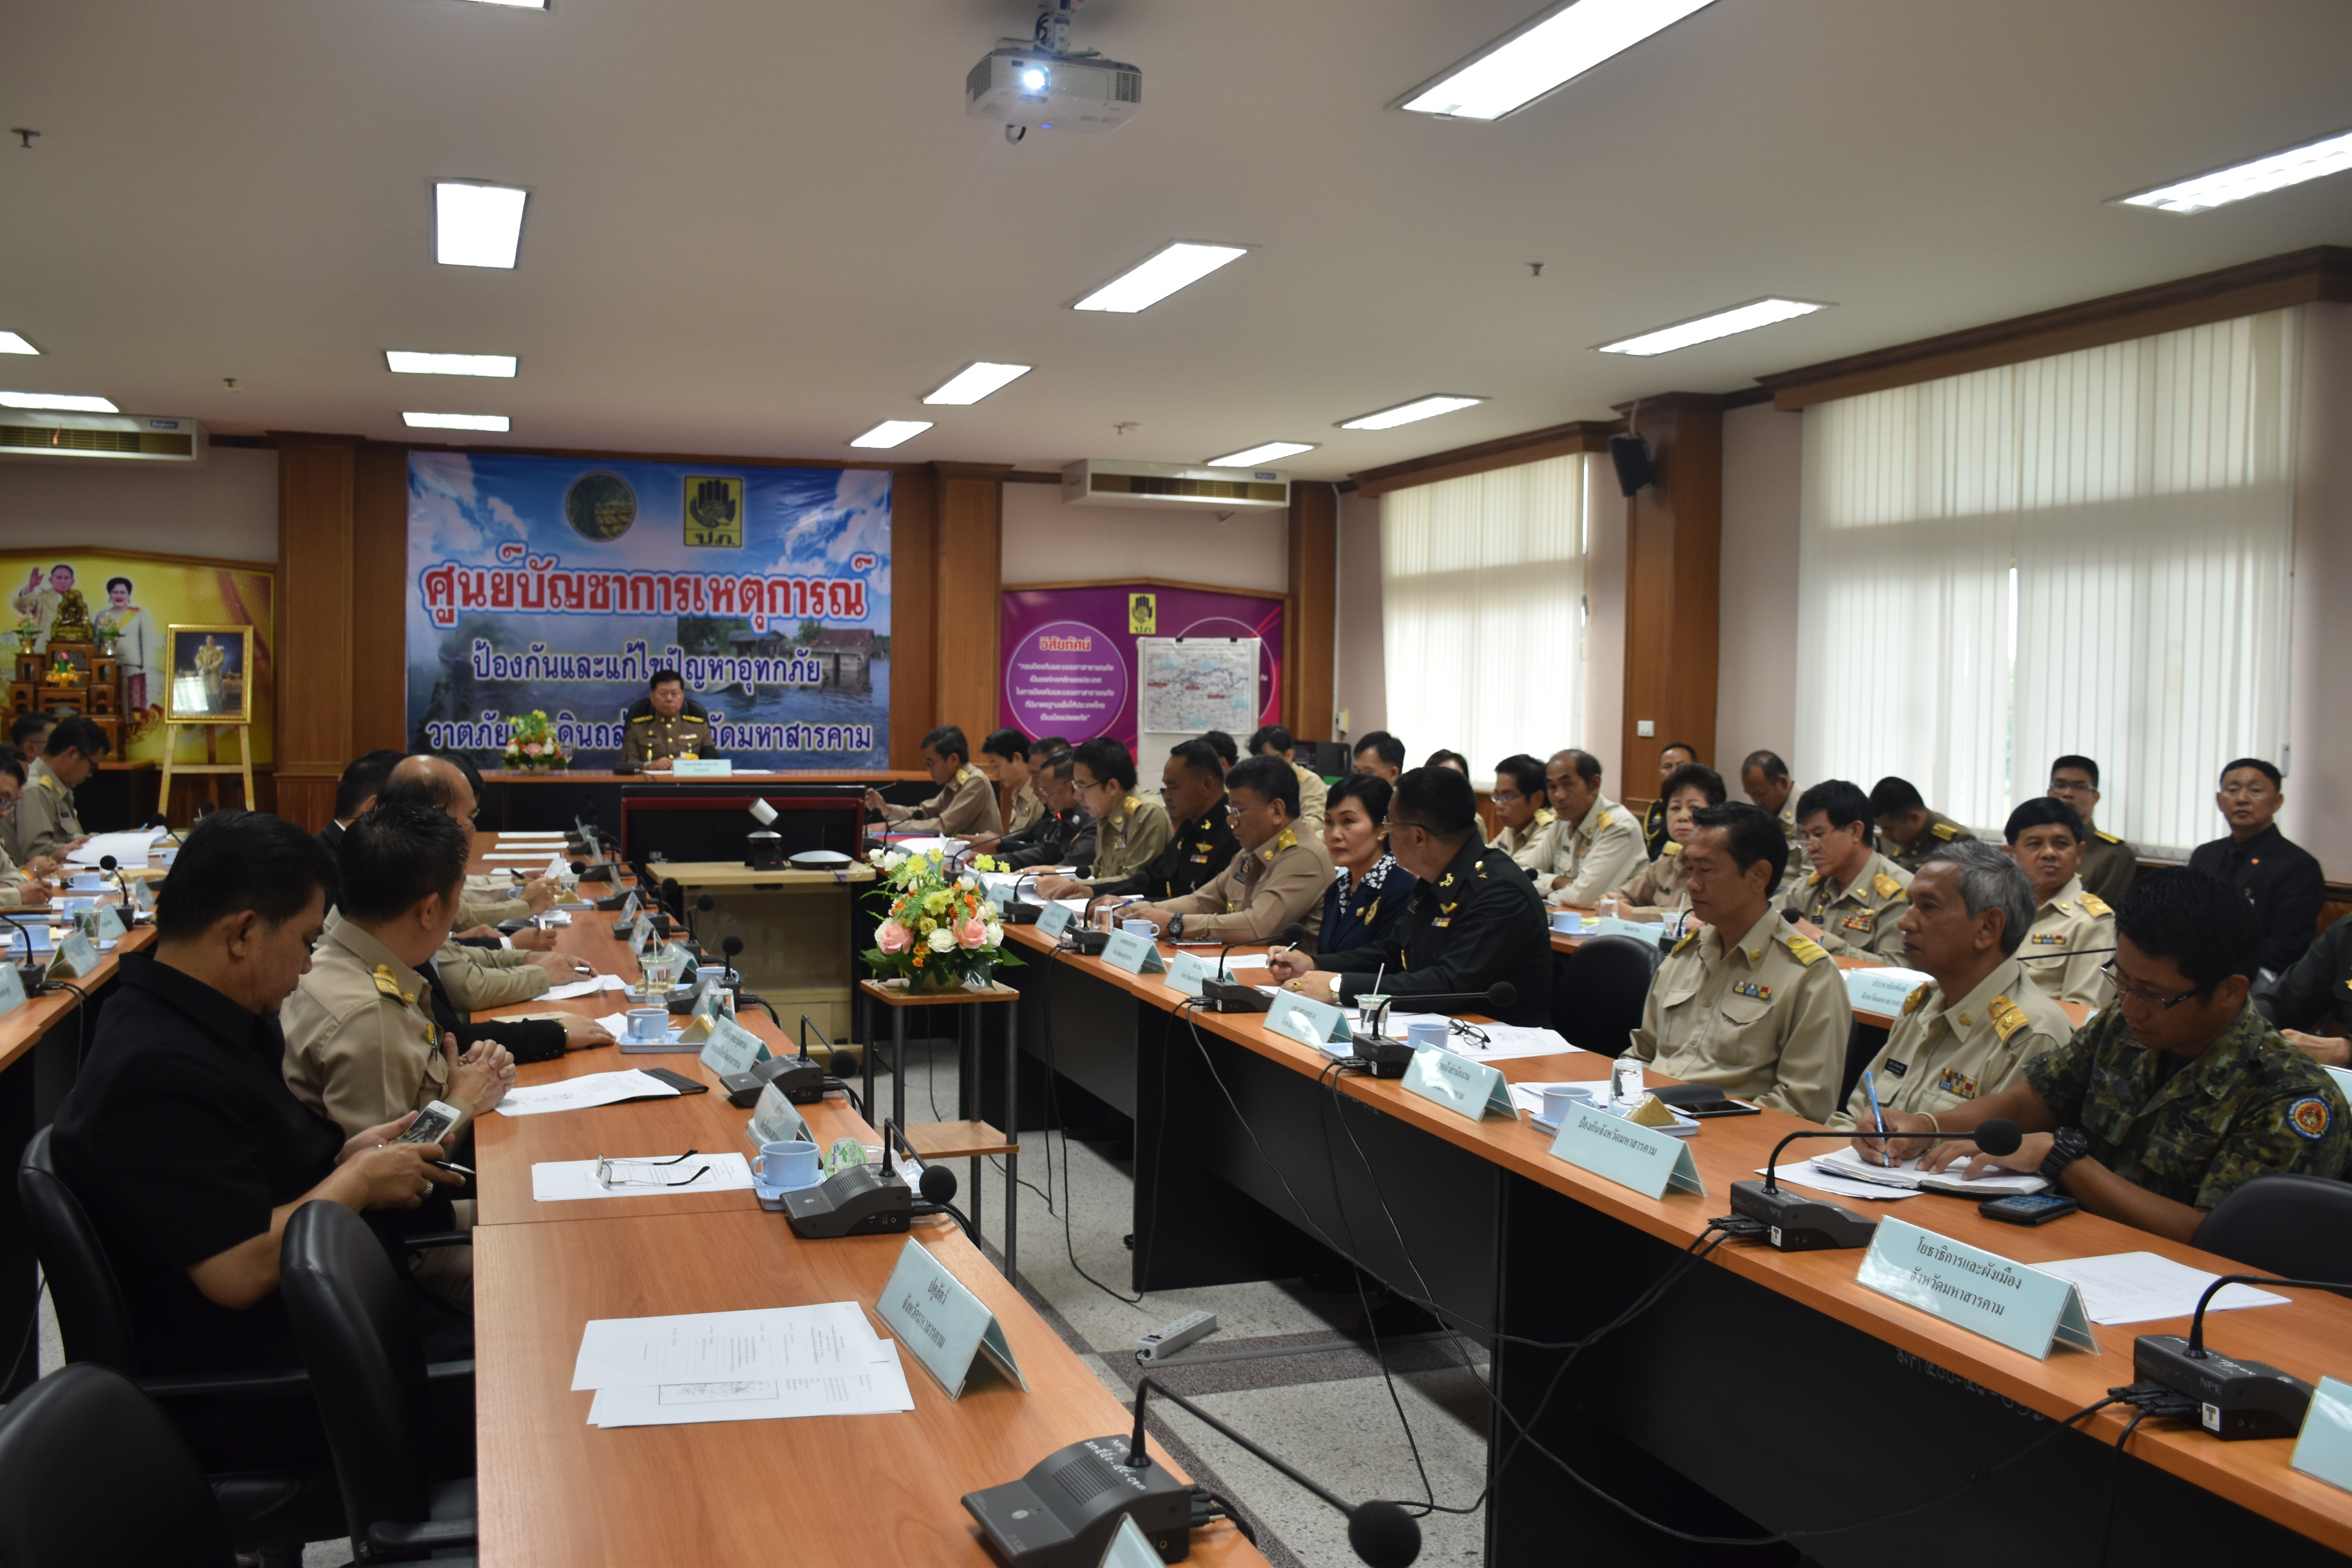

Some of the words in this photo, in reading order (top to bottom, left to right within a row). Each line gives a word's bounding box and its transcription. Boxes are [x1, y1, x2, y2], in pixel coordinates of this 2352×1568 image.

[425, 546, 873, 630] ศูนย์บัญชาการเหตุการณ์
[1040, 637, 1091, 651] วิสัยทัศน์
[474, 640, 822, 691] ป้องกันและแก้ไขปัญหาอุทกภัย
[1578, 1115, 1658, 1156] ป้องกันจังหวัดมหาสารคาม
[1768, 1206, 1783, 1217] NPE
[1916, 1236, 2022, 1290] โยธาธิการและผังเมือง
[928, 1276, 952, 1305] ปศุสัตว์
[1910, 1266, 2005, 1316] จังหวัดมหาสารคาม
[902, 1294, 946, 1349] จังหวัดมหาสารคาม
[2200, 1377, 2223, 1394] NPE
[1110, 1439, 1131, 1453] NPE
